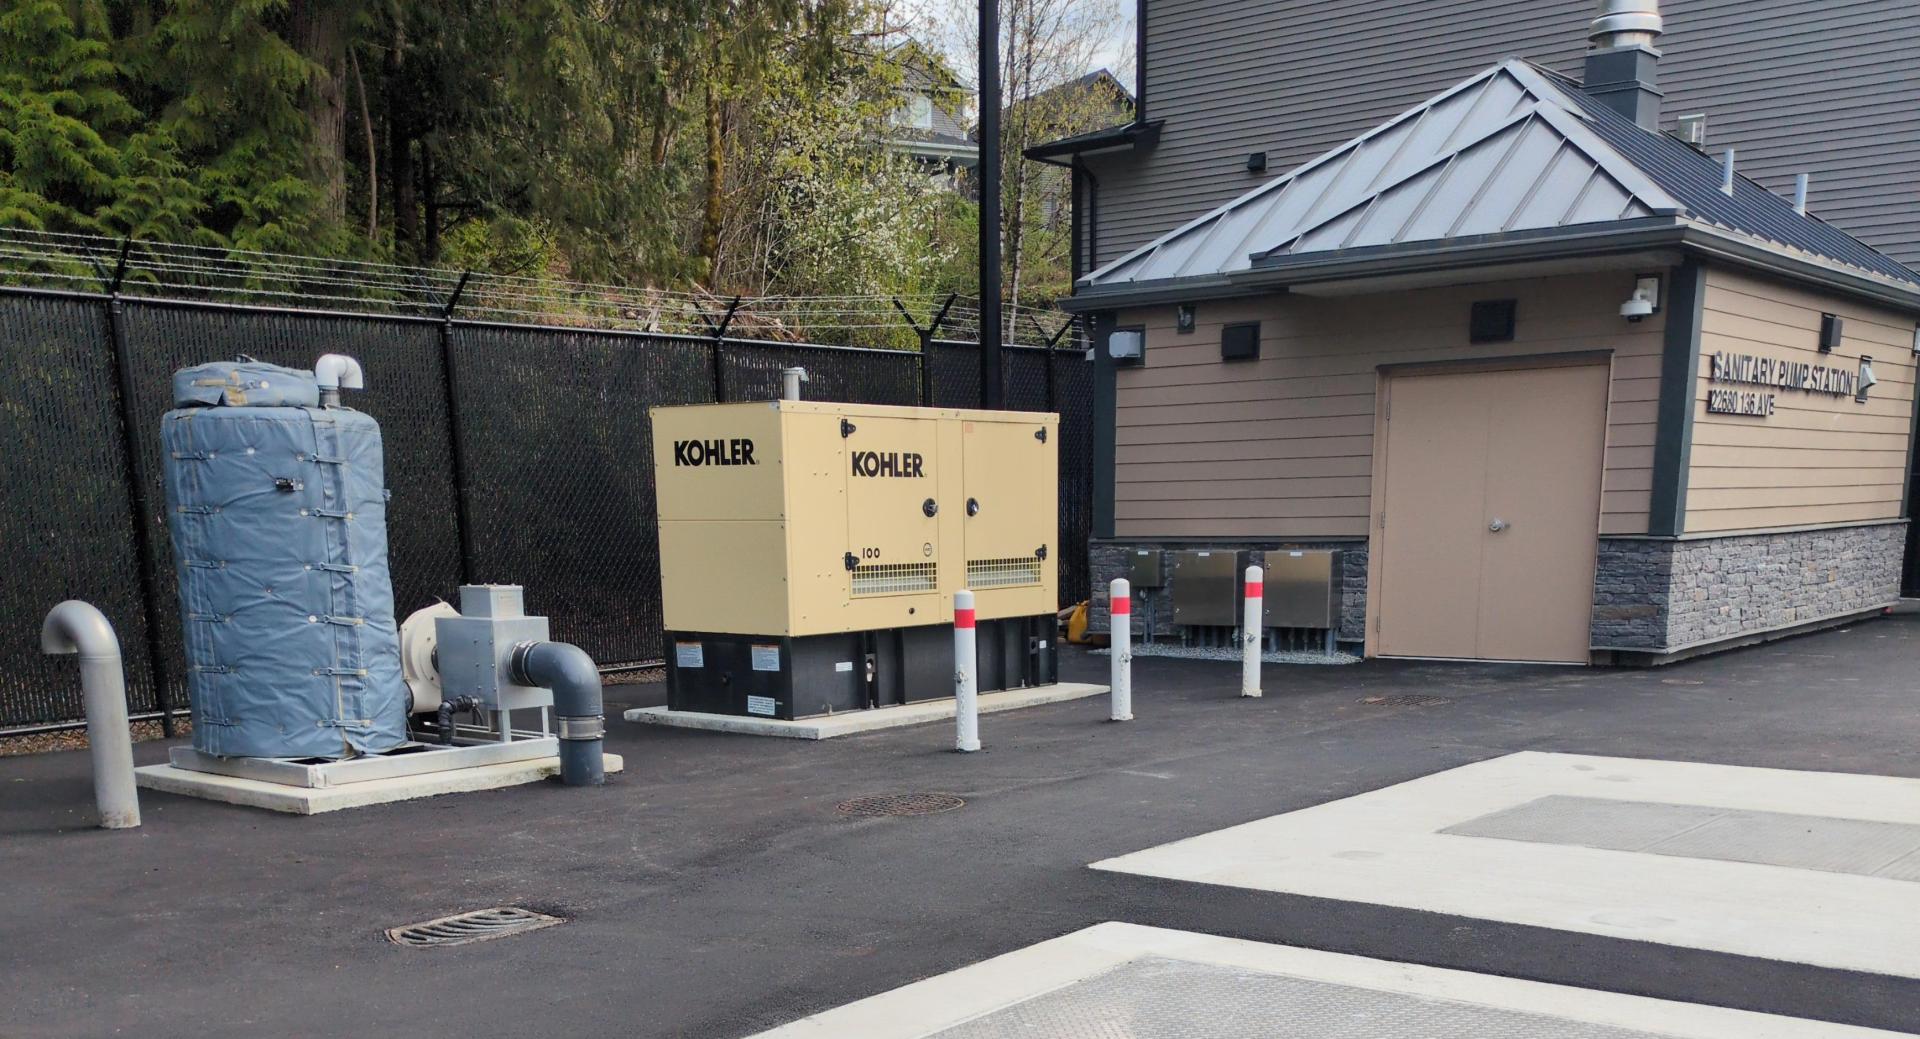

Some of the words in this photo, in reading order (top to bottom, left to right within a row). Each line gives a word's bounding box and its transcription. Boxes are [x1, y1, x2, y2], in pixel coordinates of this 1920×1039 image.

[1713, 351, 1776, 386] SANITARY
[1778, 361, 1809, 390] PUMP
[1811, 365, 1853, 395] STATION
[1711, 389, 1738, 412] 22680
[1740, 391, 1755, 414] 136
[1757, 393, 1775, 415] AVE
[674, 439, 755, 466] KOHLER
[852, 451, 923, 477] KOHLER
[862, 547, 880, 559] 100
